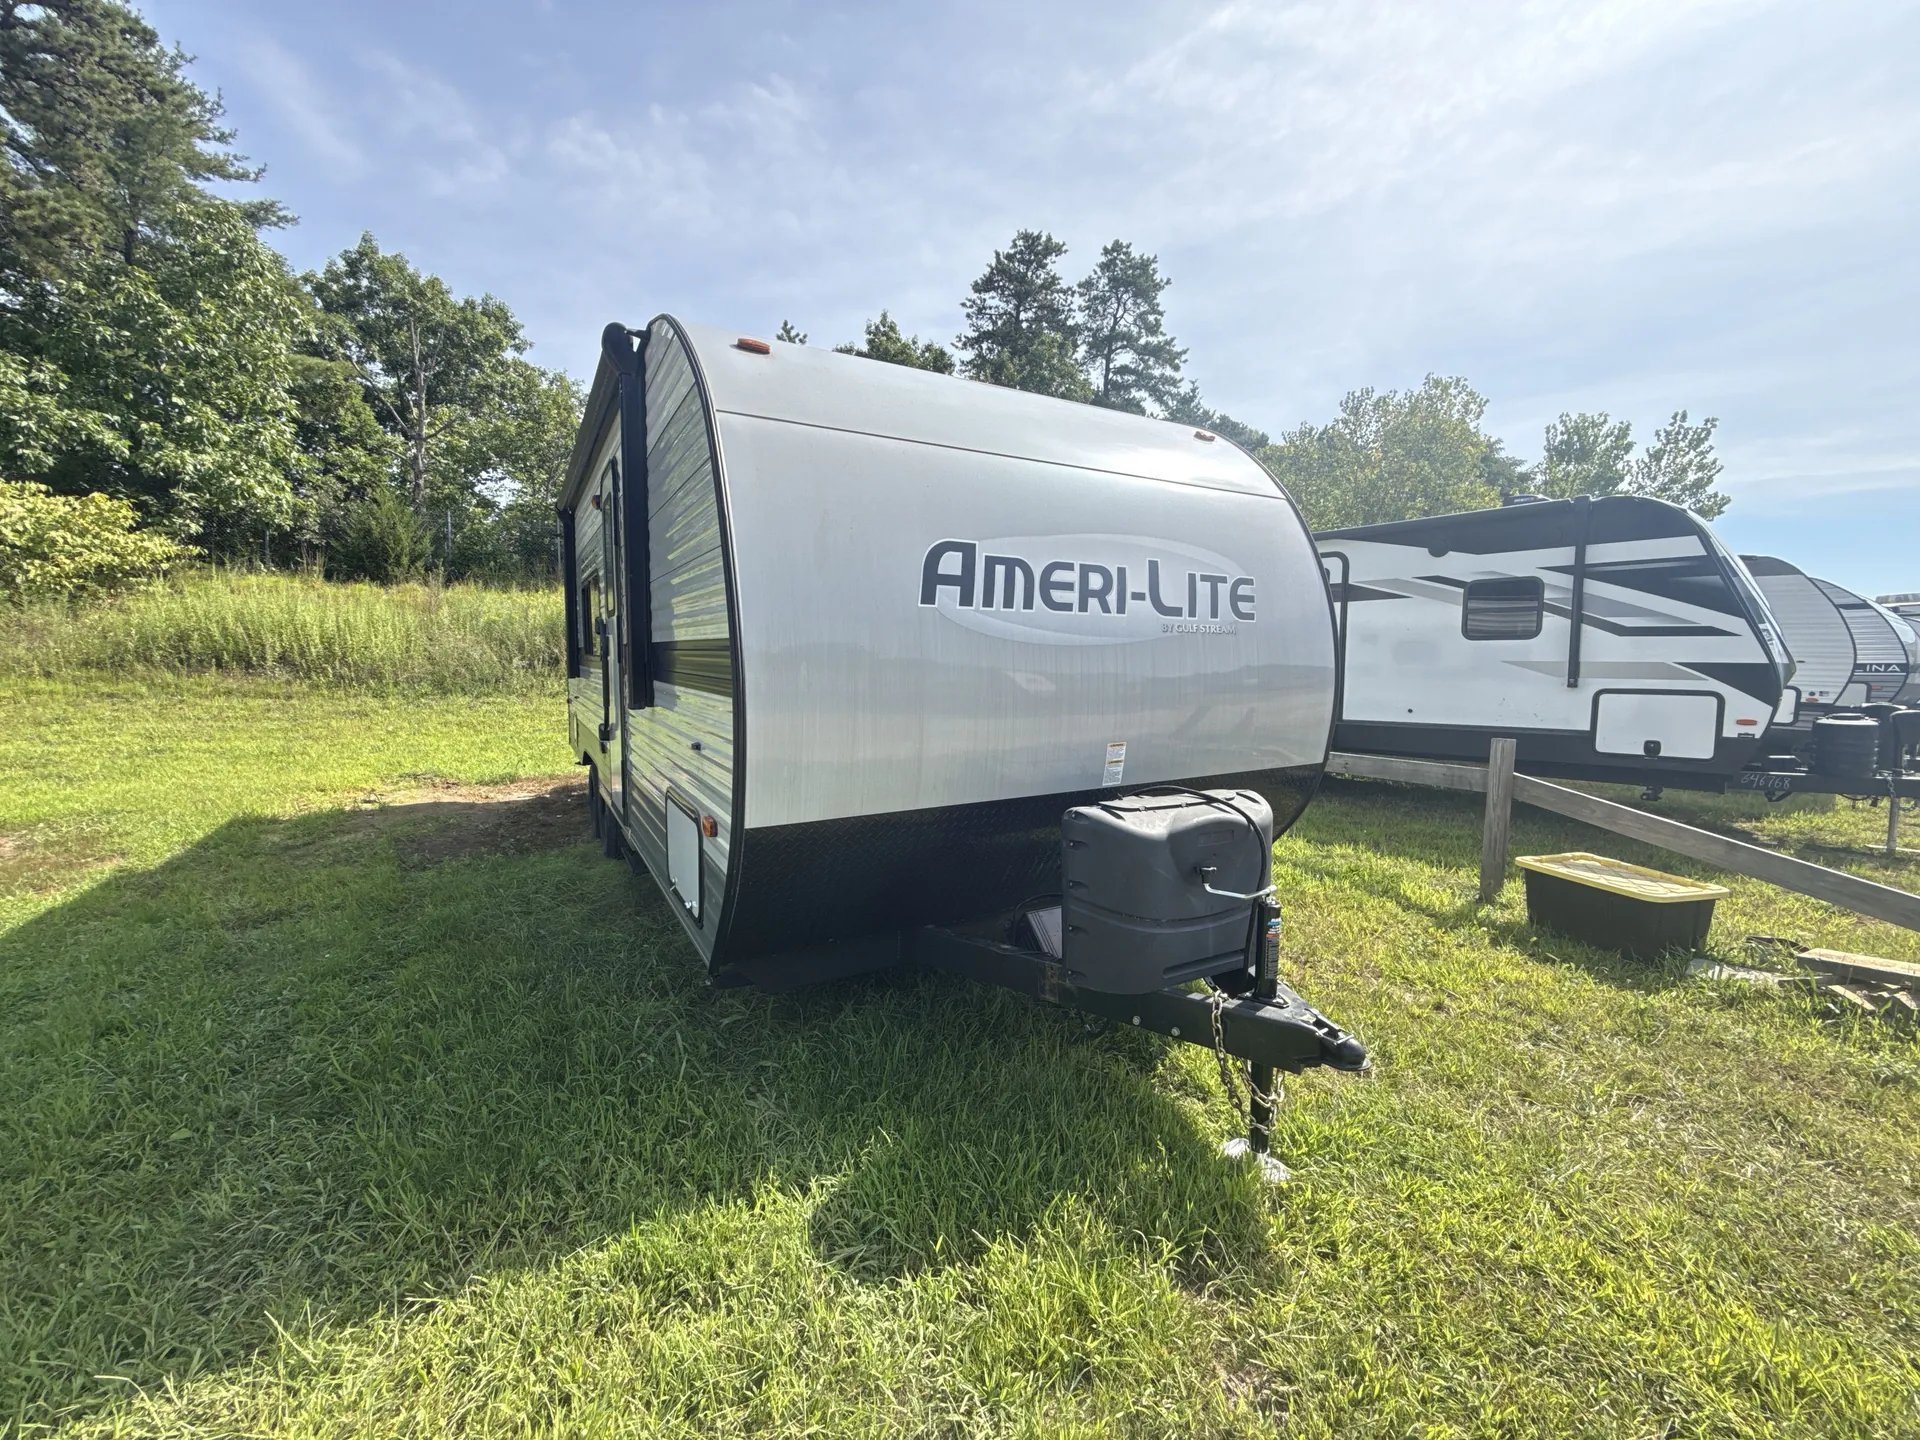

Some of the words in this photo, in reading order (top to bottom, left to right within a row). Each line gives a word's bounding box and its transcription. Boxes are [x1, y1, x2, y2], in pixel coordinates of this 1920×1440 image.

[918, 538, 1257, 622] AMERI-LITE
[1162, 623, 1175, 633] BY
[1175, 623, 1198, 634] GULF
[1199, 624, 1236, 635] STREAM
